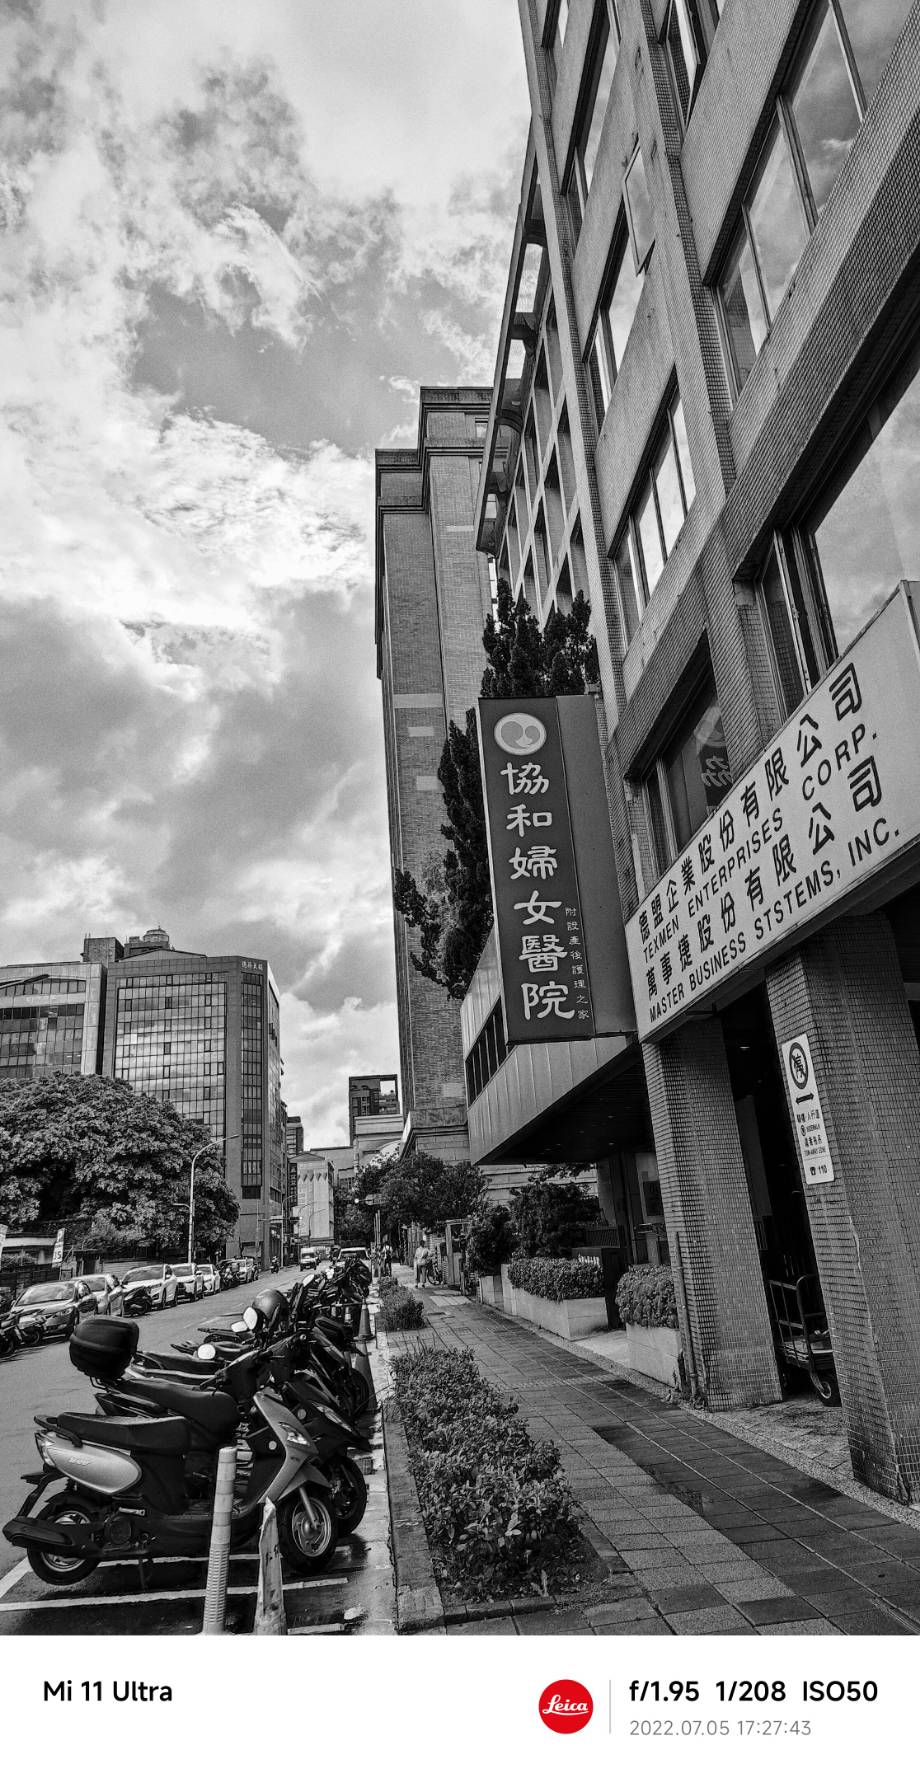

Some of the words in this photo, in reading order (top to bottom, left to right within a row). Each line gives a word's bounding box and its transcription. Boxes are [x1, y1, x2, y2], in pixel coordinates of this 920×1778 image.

[500, 762, 576, 1021] 協和婦女醫院
[643, 914, 680, 963] TEXMEN
[687, 807, 783, 919] ENTERPRISES
[801, 722, 878, 801] CORP.
[645, 754, 883, 1001] 萬事捷股份有限公司
[649, 981, 685, 1023] MASTER
[687, 930, 747, 992] BUSINESS
[846, 816, 900, 867] INC.
[818, 1165, 828, 1175] 110
